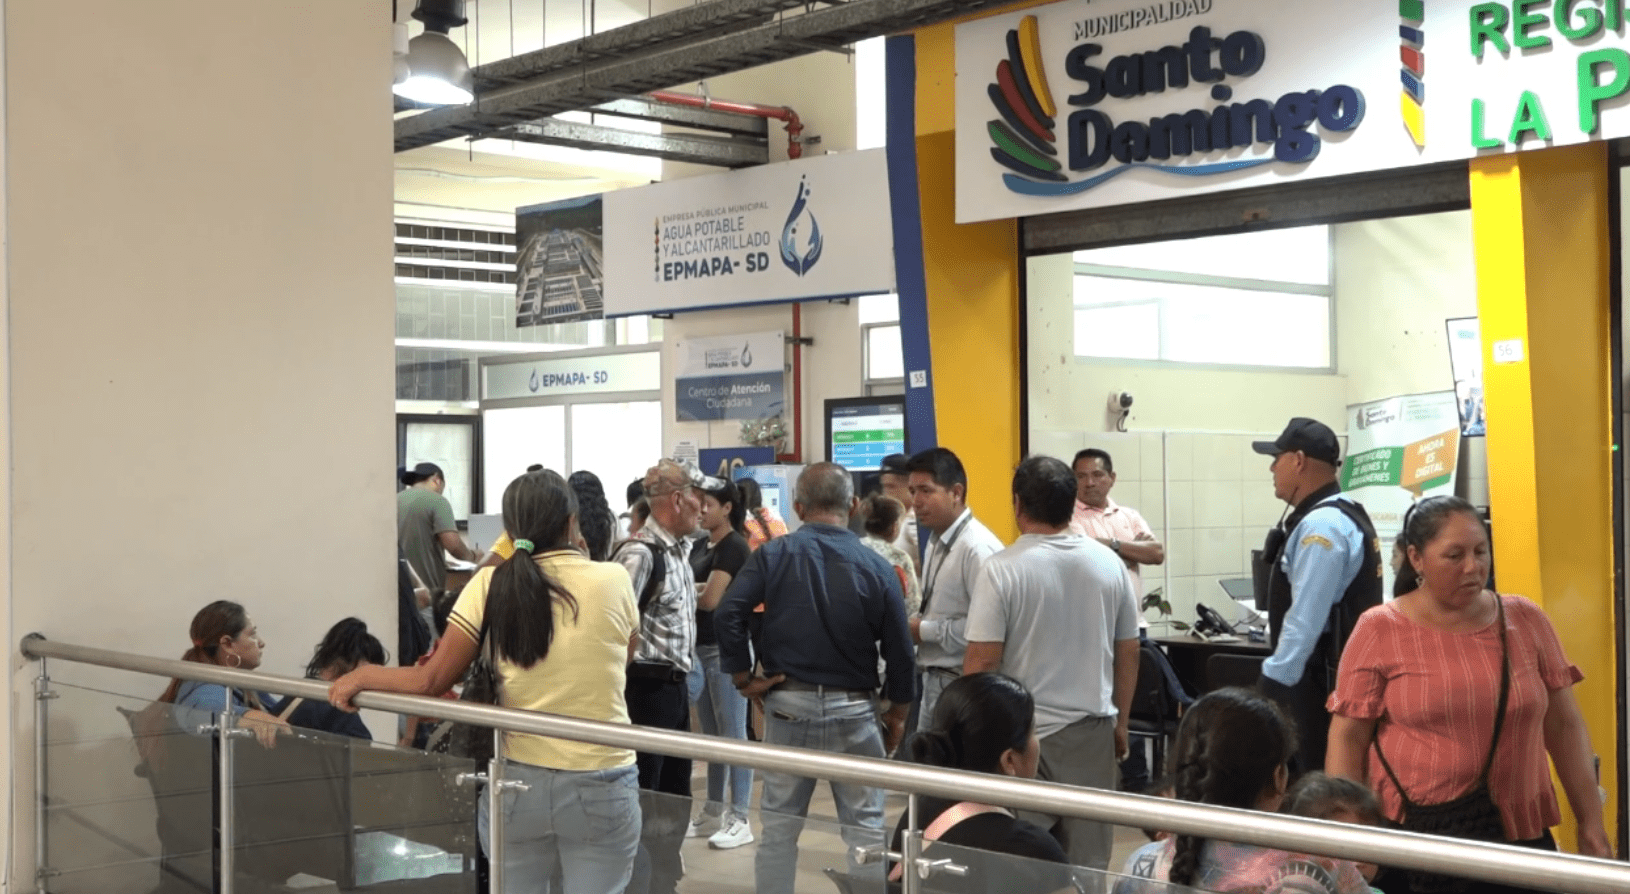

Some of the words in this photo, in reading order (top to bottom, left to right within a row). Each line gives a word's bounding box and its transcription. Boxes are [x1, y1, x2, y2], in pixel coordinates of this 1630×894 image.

[1074, 0, 1212, 41] MUNICIPALIDAD
[1469, 0, 1630, 60] REGI
[1065, 25, 1265, 106] Santo
[1067, 83, 1365, 171] Domingo
[1471, 90, 1553, 148] LA
[662, 210, 695, 224] EMPRESA
[696, 206, 727, 219] PÚBLICA
[728, 201, 769, 214] MUNICIPAL
[663, 224, 693, 241] AGUA
[695, 216, 745, 236] POTABLE
[663, 243, 671, 257] Y
[670, 230, 770, 257] ALCANTARILLADO
[746, 251, 770, 273] SD
[1497, 343, 1513, 357] 56
[593, 370, 609, 385] SD
[688, 386, 717, 398] Centro
[718, 385, 729, 396] de
[730, 381, 771, 395] Atención
[706, 396, 753, 409] Ciudadana
